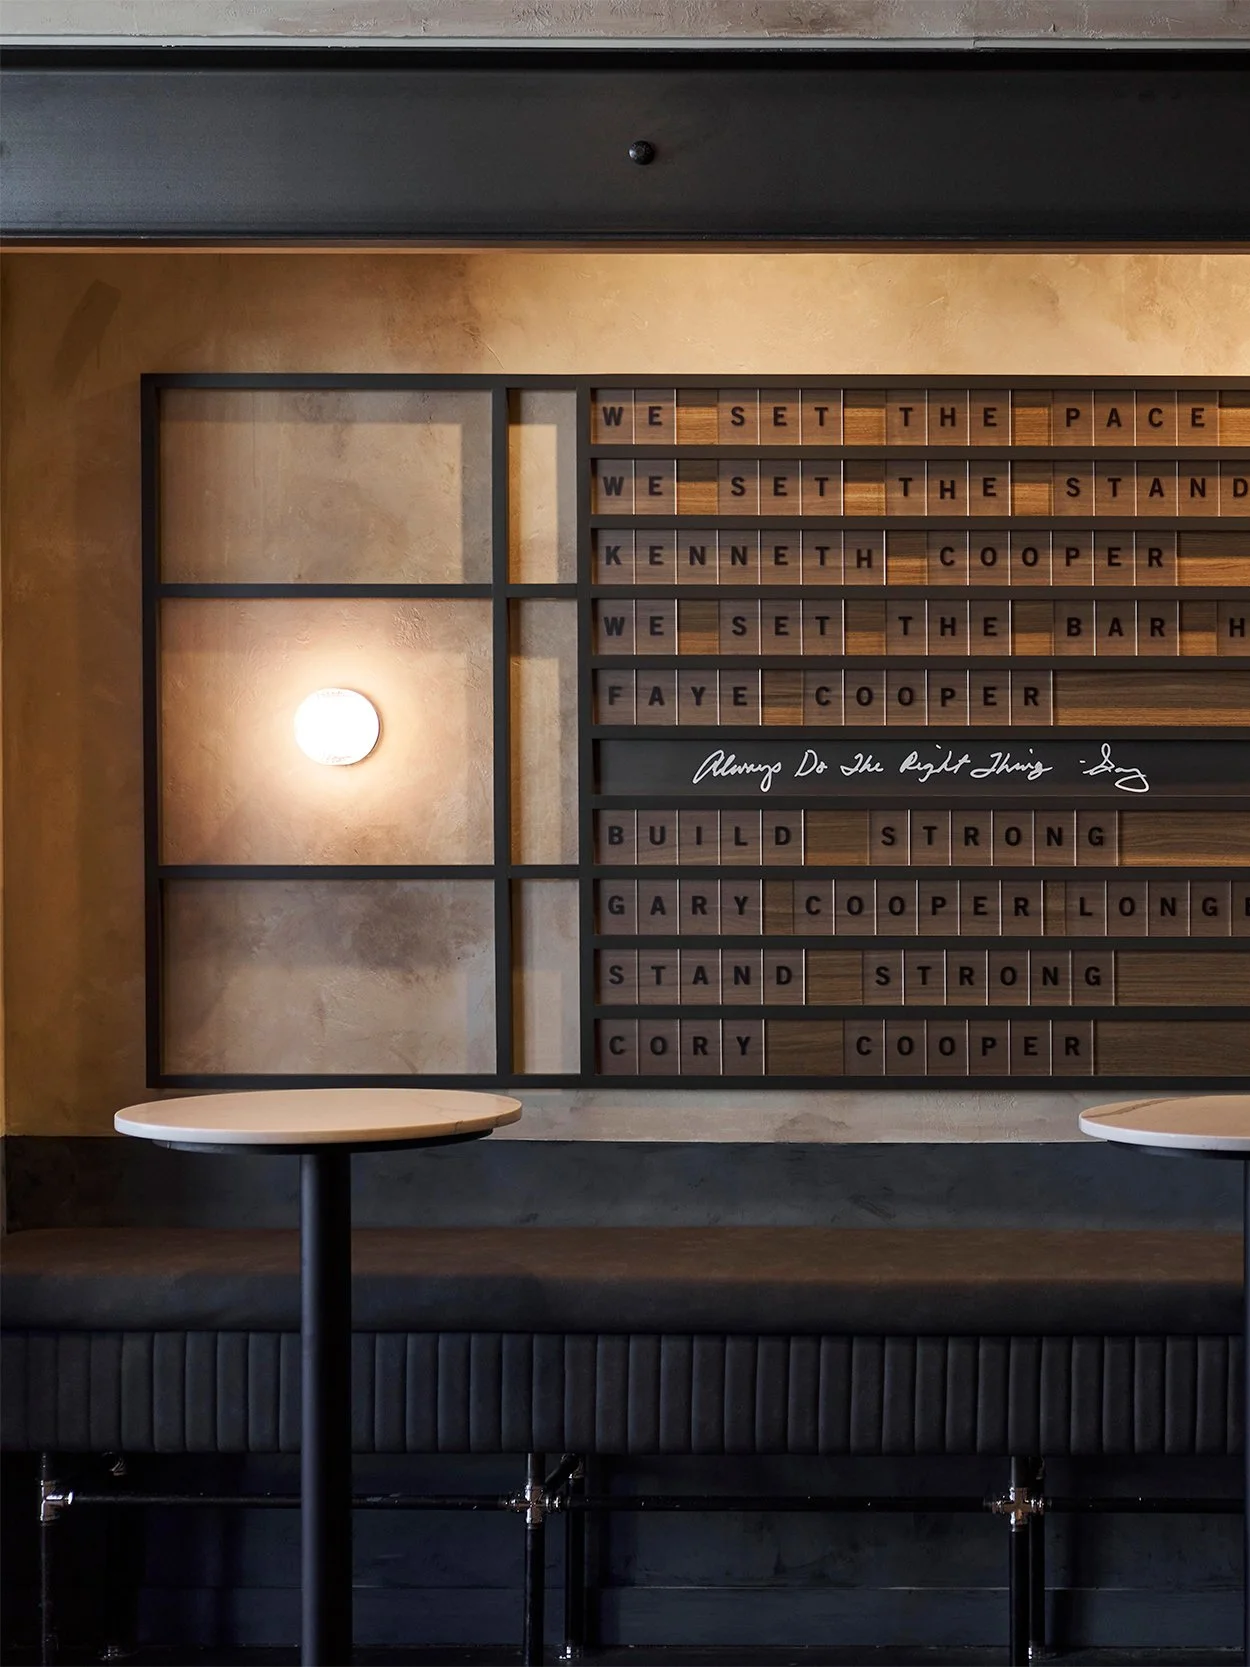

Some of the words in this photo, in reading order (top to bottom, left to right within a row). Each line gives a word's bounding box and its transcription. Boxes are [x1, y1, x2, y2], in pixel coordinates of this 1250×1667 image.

[603, 407, 663, 427] WE
[730, 407, 828, 427] SET
[899, 408, 996, 428] THE
[1066, 407, 1205, 429] PACE
[603, 477, 663, 497] WE
[731, 477, 828, 497] SET
[899, 477, 996, 500] THE
[605, 546, 872, 569] KENNETH
[940, 547, 1163, 567] COOPER
[603, 617, 664, 636] WE
[732, 617, 829, 636] SET
[899, 617, 996, 637] THE
[1068, 617, 1165, 637] BAR
[609, 686, 747, 706] FAYE
[815, 686, 1039, 707] COOPER
[693, 749, 783, 792] Always
[794, 749, 828, 779] Do
[839, 753, 885, 773] The
[899, 744, 971, 782] Right
[970, 749, 1053, 780] Thing
[608, 826, 791, 846] BUILD
[881, 826, 1104, 847] STRONG
[608, 896, 748, 915] GARY
[805, 896, 1030, 916] COOPER
[609, 966, 792, 986] STAND
[876, 966, 1101, 987] STRONG
[609, 1035, 750, 1056] CORY
[857, 1036, 1080, 1057] COOPER
